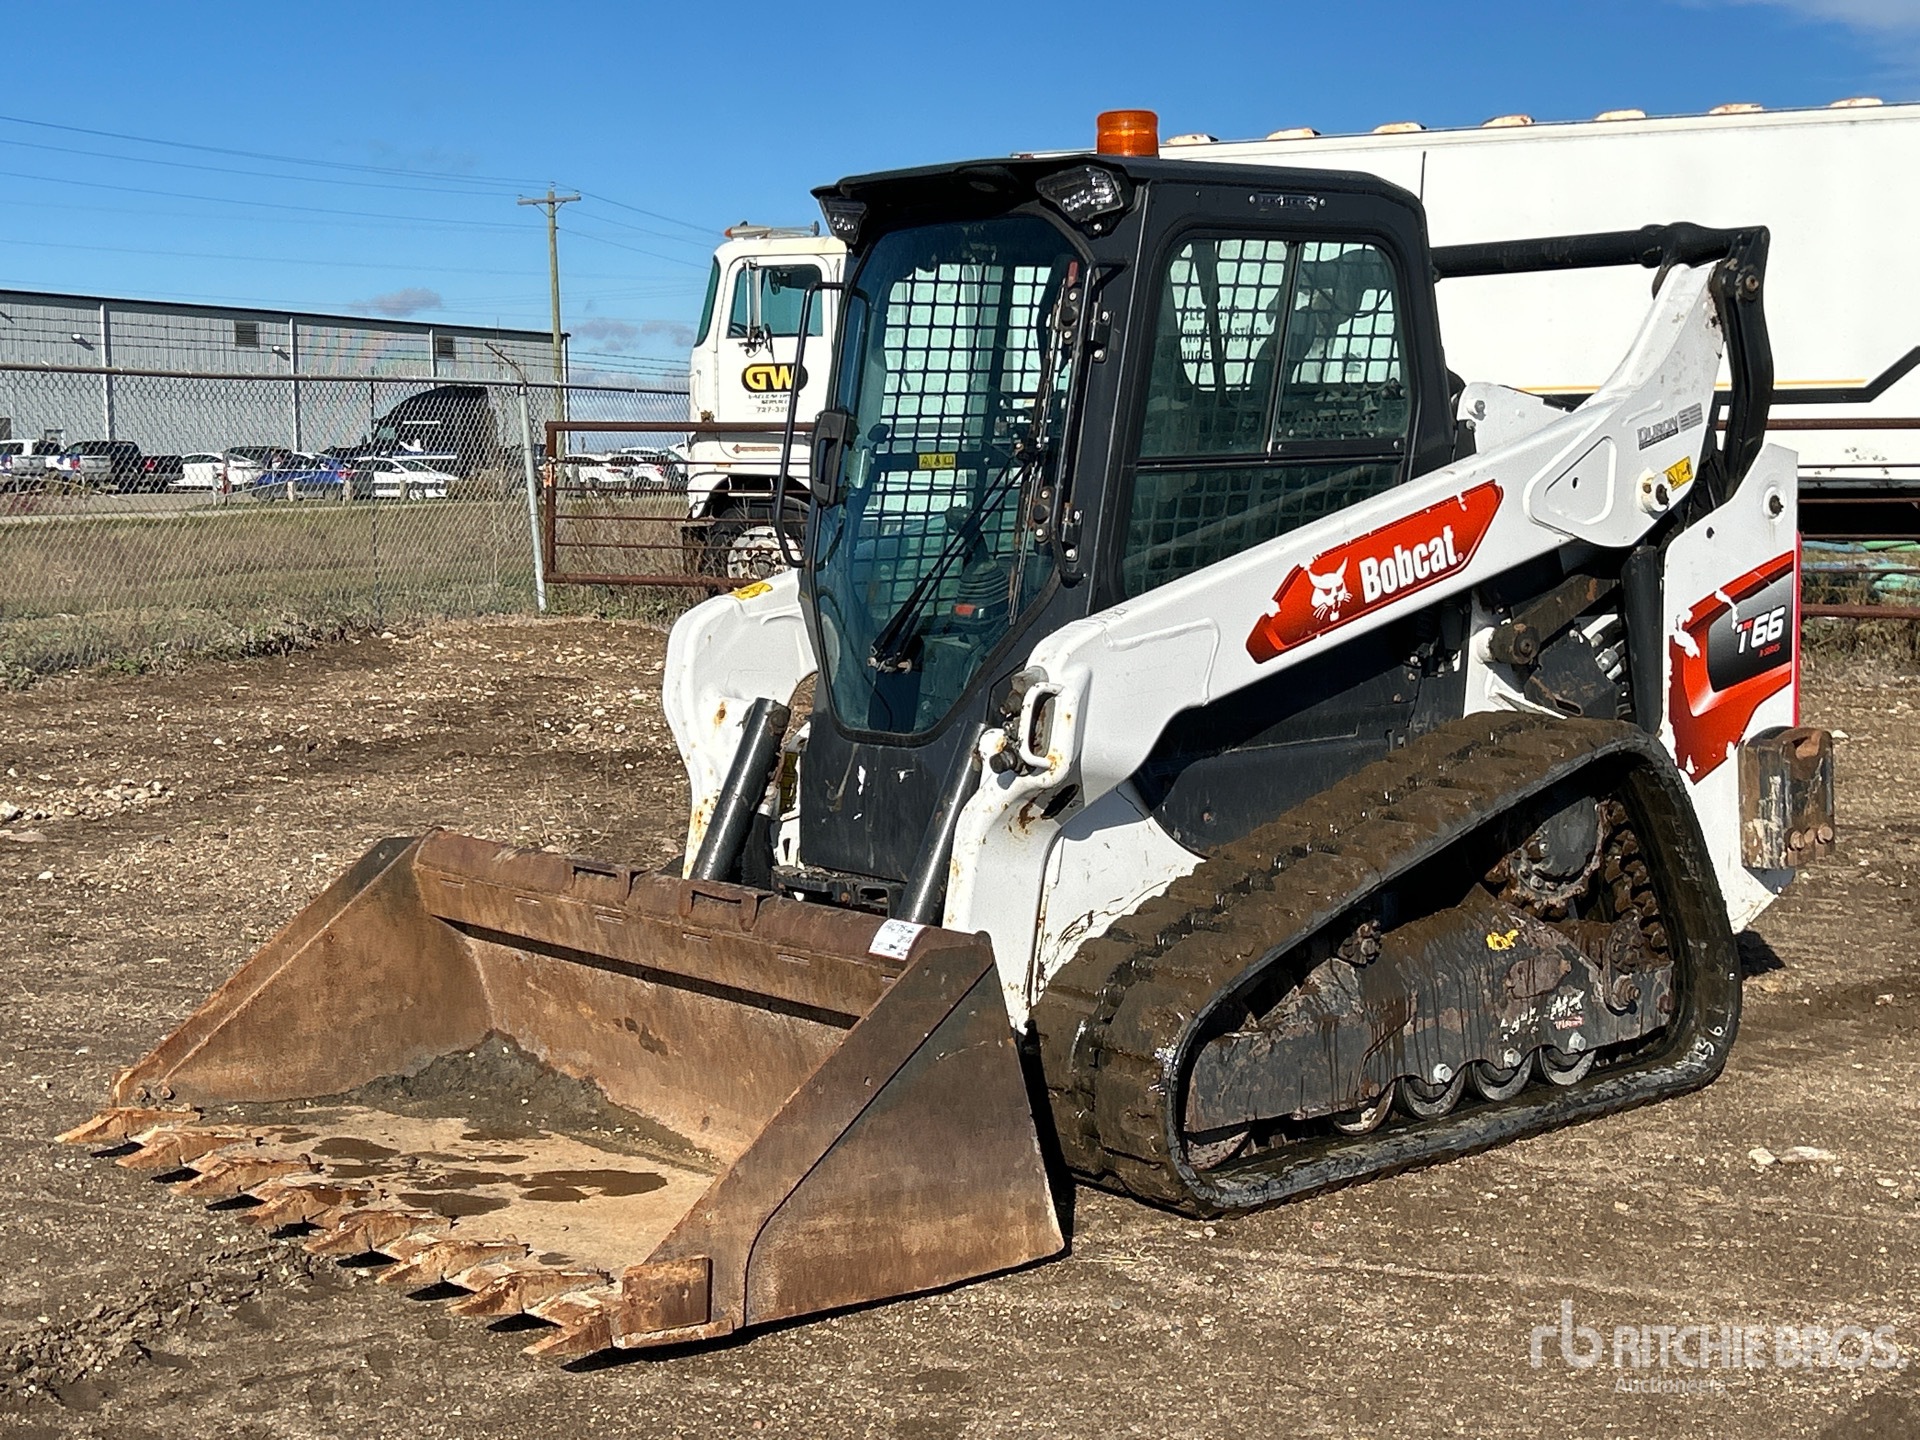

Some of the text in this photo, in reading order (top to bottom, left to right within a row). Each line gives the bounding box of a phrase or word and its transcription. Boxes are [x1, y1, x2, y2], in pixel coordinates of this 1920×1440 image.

[745, 365, 795, 390] GW
[1359, 525, 1457, 604] Bobcat
[1736, 606, 1786, 654] T66
